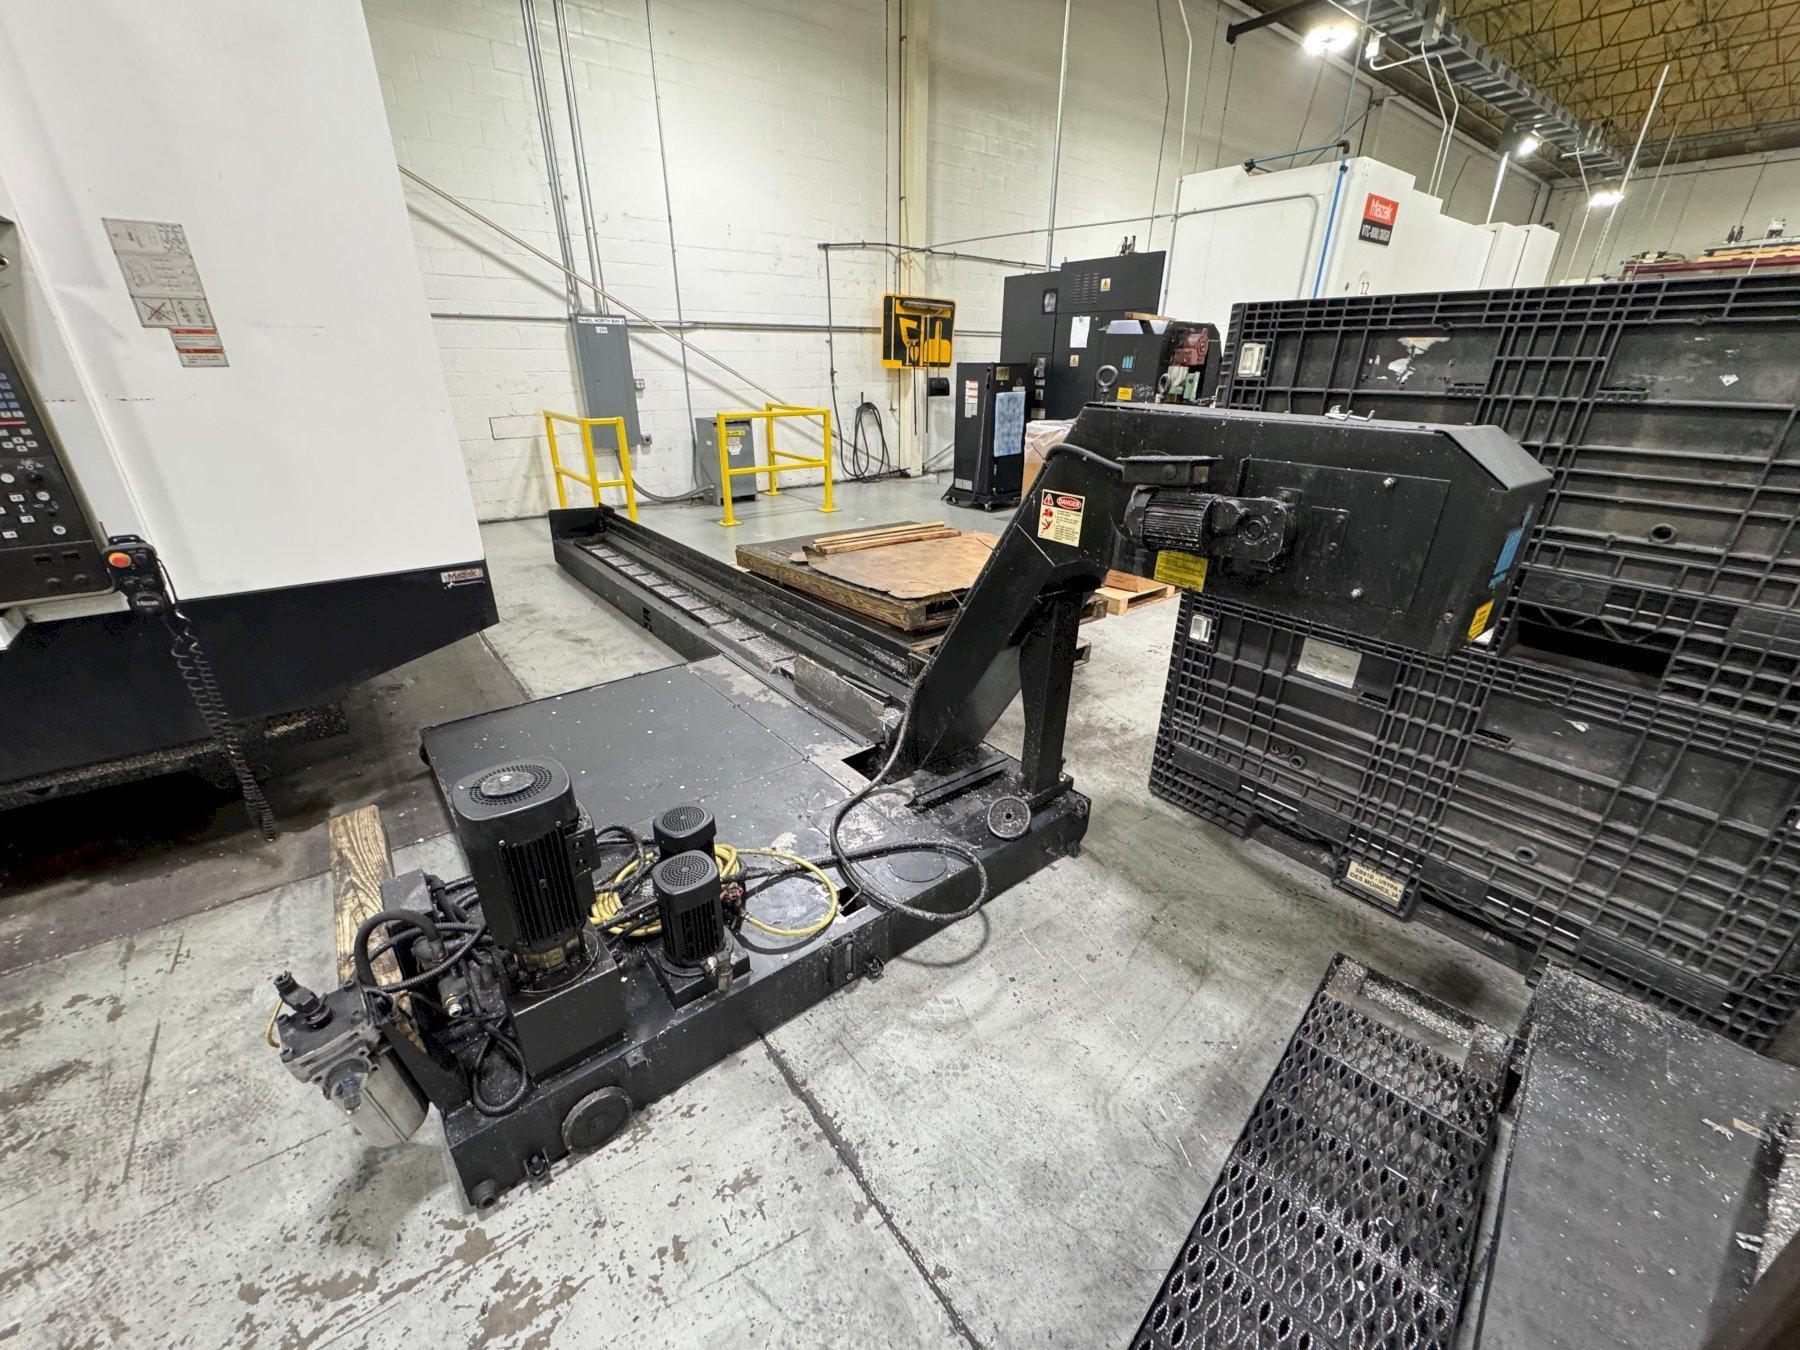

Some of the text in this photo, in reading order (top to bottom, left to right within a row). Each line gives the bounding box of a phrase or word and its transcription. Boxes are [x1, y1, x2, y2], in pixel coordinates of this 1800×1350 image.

[1370, 199, 1393, 220] Mazak
[1360, 282, 1370, 295] 12
[1058, 498, 1080, 507] DANGER
[448, 570, 476, 580] Mazak
[1350, 871, 1363, 881] DES
